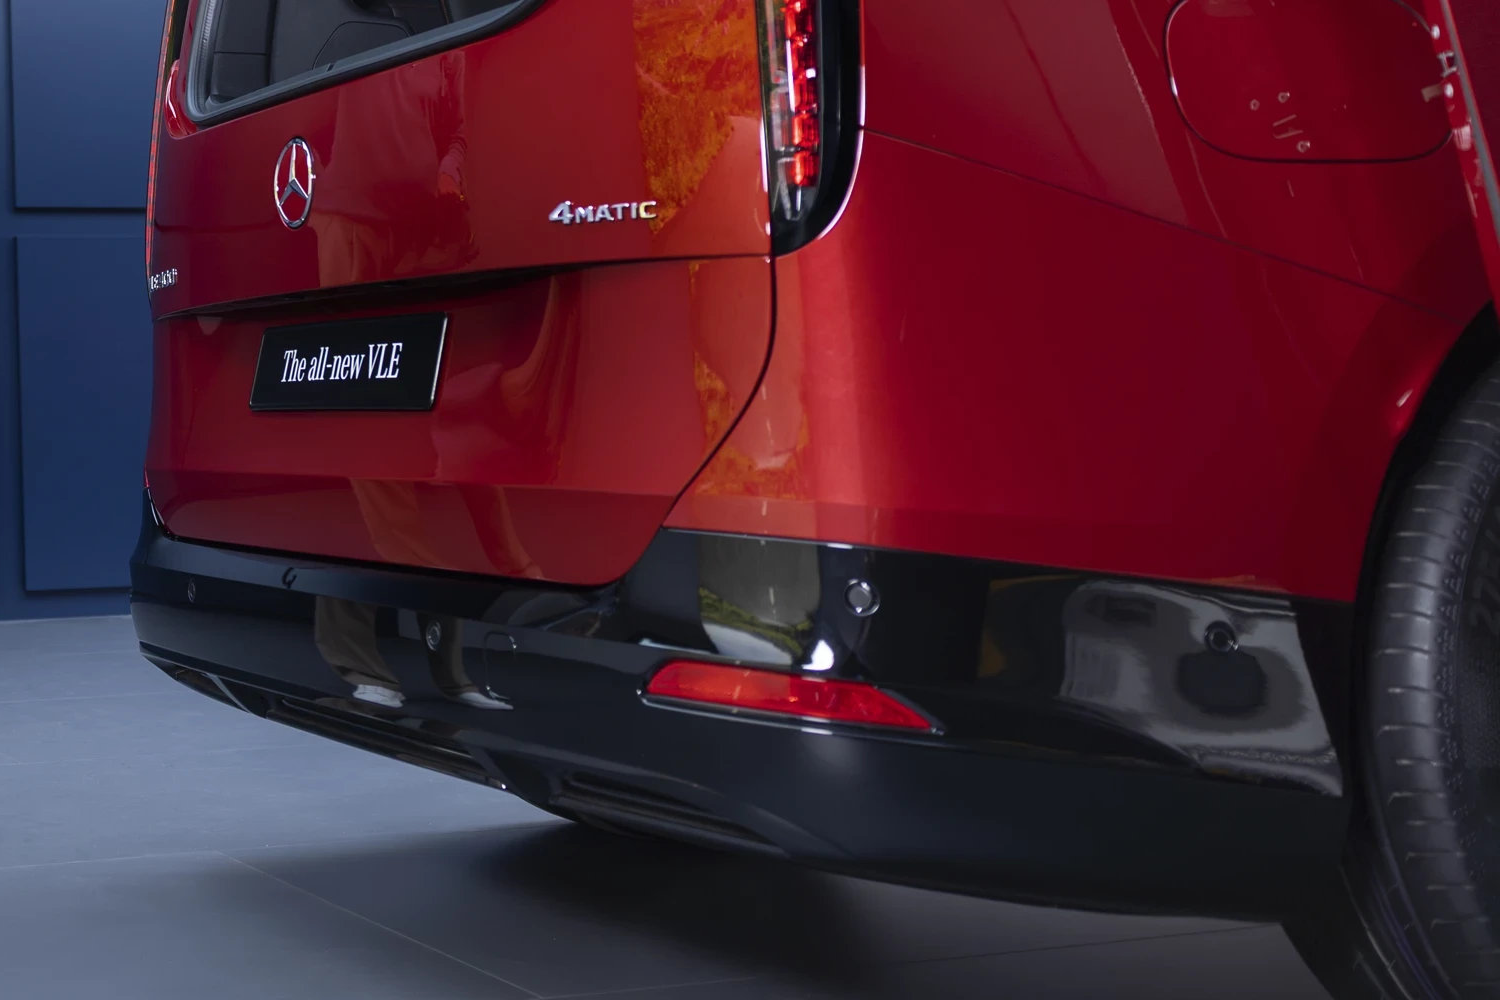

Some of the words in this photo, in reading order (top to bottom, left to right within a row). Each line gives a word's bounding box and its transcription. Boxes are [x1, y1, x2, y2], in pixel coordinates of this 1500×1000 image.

[548, 200, 657, 225] 4MATIC
[281, 348, 307, 383] The
[307, 346, 366, 382] all-new
[368, 342, 403, 379] VLE
